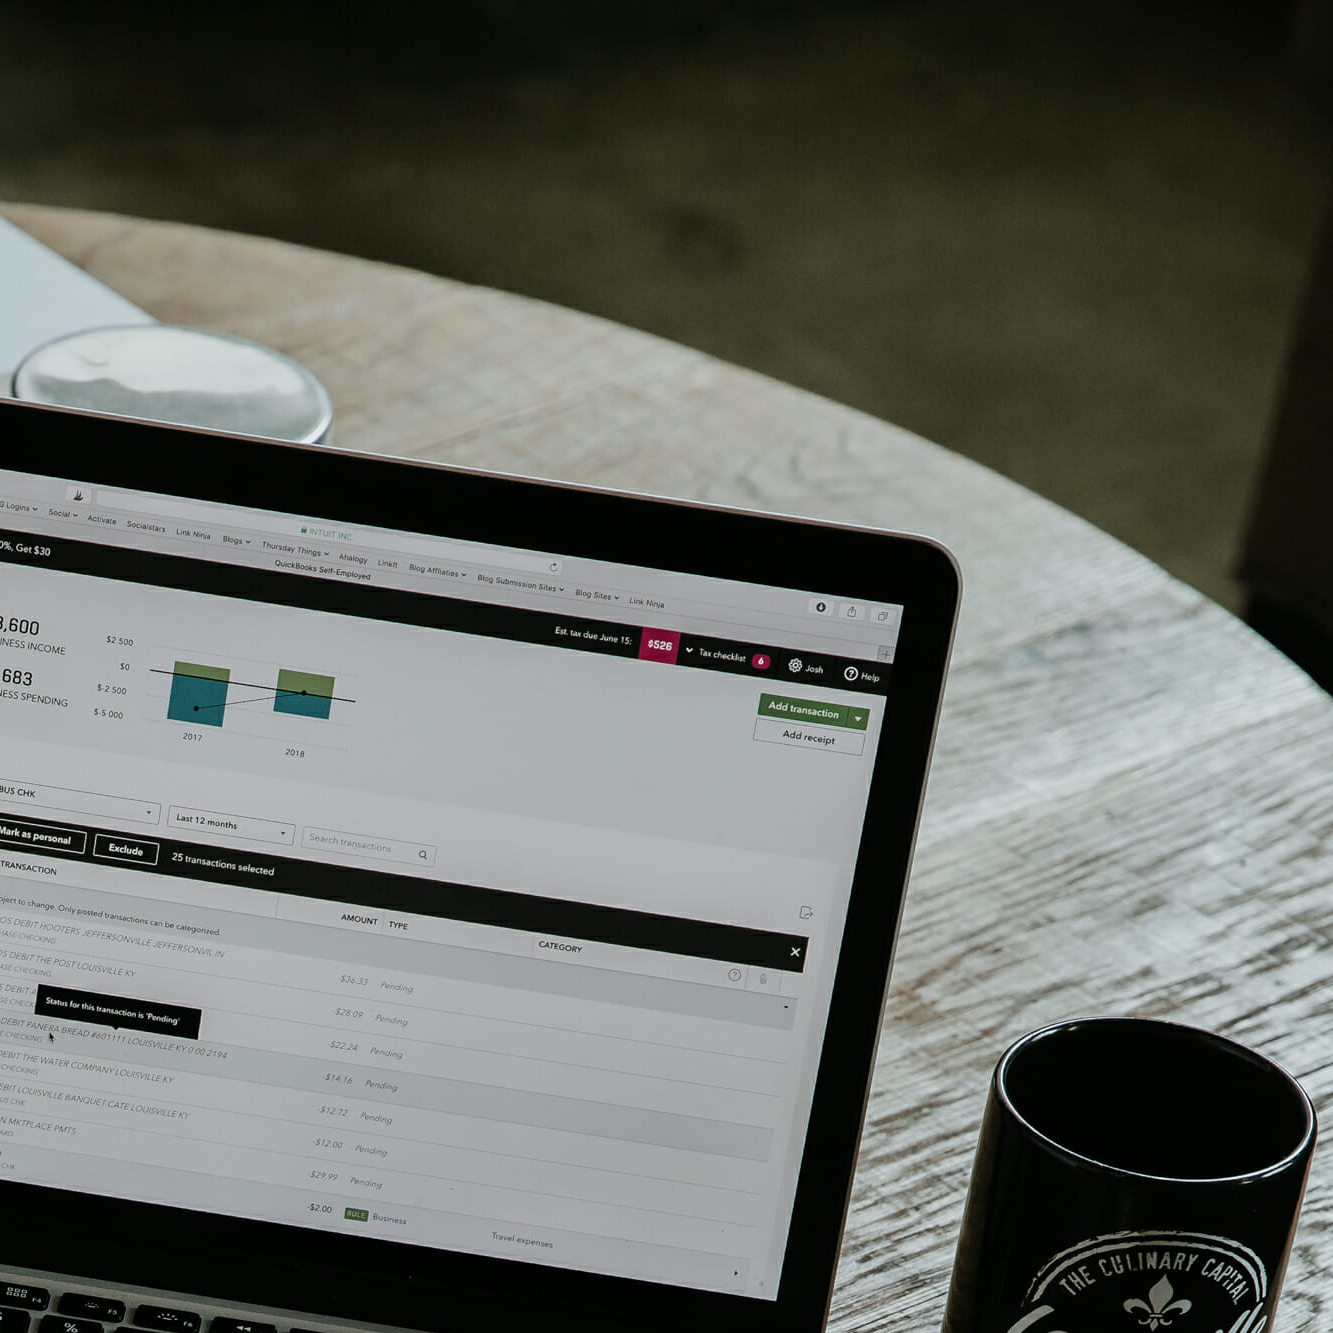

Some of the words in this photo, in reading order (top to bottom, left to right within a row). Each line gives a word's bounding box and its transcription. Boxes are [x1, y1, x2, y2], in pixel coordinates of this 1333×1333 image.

[5, 500, 31, 513] Logins
[47, 507, 72, 518] Social
[86, 513, 118, 526] Activate
[125, 519, 166, 534] Socialstars
[175, 527, 191, 537] Link
[191, 529, 212, 541] Ninja
[221, 534, 243, 546] Blogs
[14, 542, 33, 554] Get
[32, 544, 52, 557] $30
[338, 552, 369, 566] Ahalogy
[376, 558, 399, 569] LinkIt
[273, 558, 318, 573] QuickBooks
[317, 565, 372, 581] Self-Employed
[553, 625, 569, 636] Est.
[569, 628, 582, 638] tax
[581, 630, 599, 641] due
[598, 632, 619, 644] June
[620, 635, 633, 646] 15:
[26, 641, 67, 656] INCOME
[646, 638, 674, 652] $526
[698, 647, 712, 658] Tax
[712, 649, 747, 663] checklist
[756, 656, 765, 666] 6
[119, 661, 131, 672] $0
[803, 663, 825, 675] Josh
[859, 671, 881, 684] Help
[19, 691, 69, 708] SPENDING
[767, 700, 790, 712] Add
[789, 704, 840, 720] transaction
[181, 731, 204, 742] 2017
[781, 728, 803, 741] Add
[802, 734, 836, 747] receipt
[284, 747, 306, 758] 2018
[15, 787, 37, 799] CHK
[175, 812, 194, 823] Last
[194, 815, 206, 825] 12
[206, 819, 238, 831] months
[20, 830, 32, 840] as
[31, 832, 72, 846] personal
[308, 831, 339, 845] Search
[339, 838, 392, 854] transactions
[107, 842, 144, 857] Exclude
[0, 859, 58, 876] TRANSACTION
[170, 851, 184, 863] 25
[184, 854, 237, 871] transactions
[237, 862, 276, 877] selected
[339, 913, 379, 926] AMOUNT
[388, 919, 409, 931] TYPE
[537, 939, 584, 954] CATEGORY
[44, 995, 69, 1008] Status
[68, 999, 81, 1009] for
[80, 1001, 96, 1012] this
[95, 1004, 138, 1018] transaction
[136, 1010, 145, 1020] is
[7, 1116, 54, 1132] MKTPLACE
[52, 1123, 77, 1135] PMTS
[306, 1202, 333, 1214] -$2.00
[371, 1211, 407, 1226] Business
[490, 1230, 516, 1243] Travel
[515, 1236, 554, 1249] expenses
[1058, 1265, 1096, 1297] THE
[1097, 1250, 1200, 1278] CULINARY
[1200, 1258, 1249, 1305] CAPITAL
